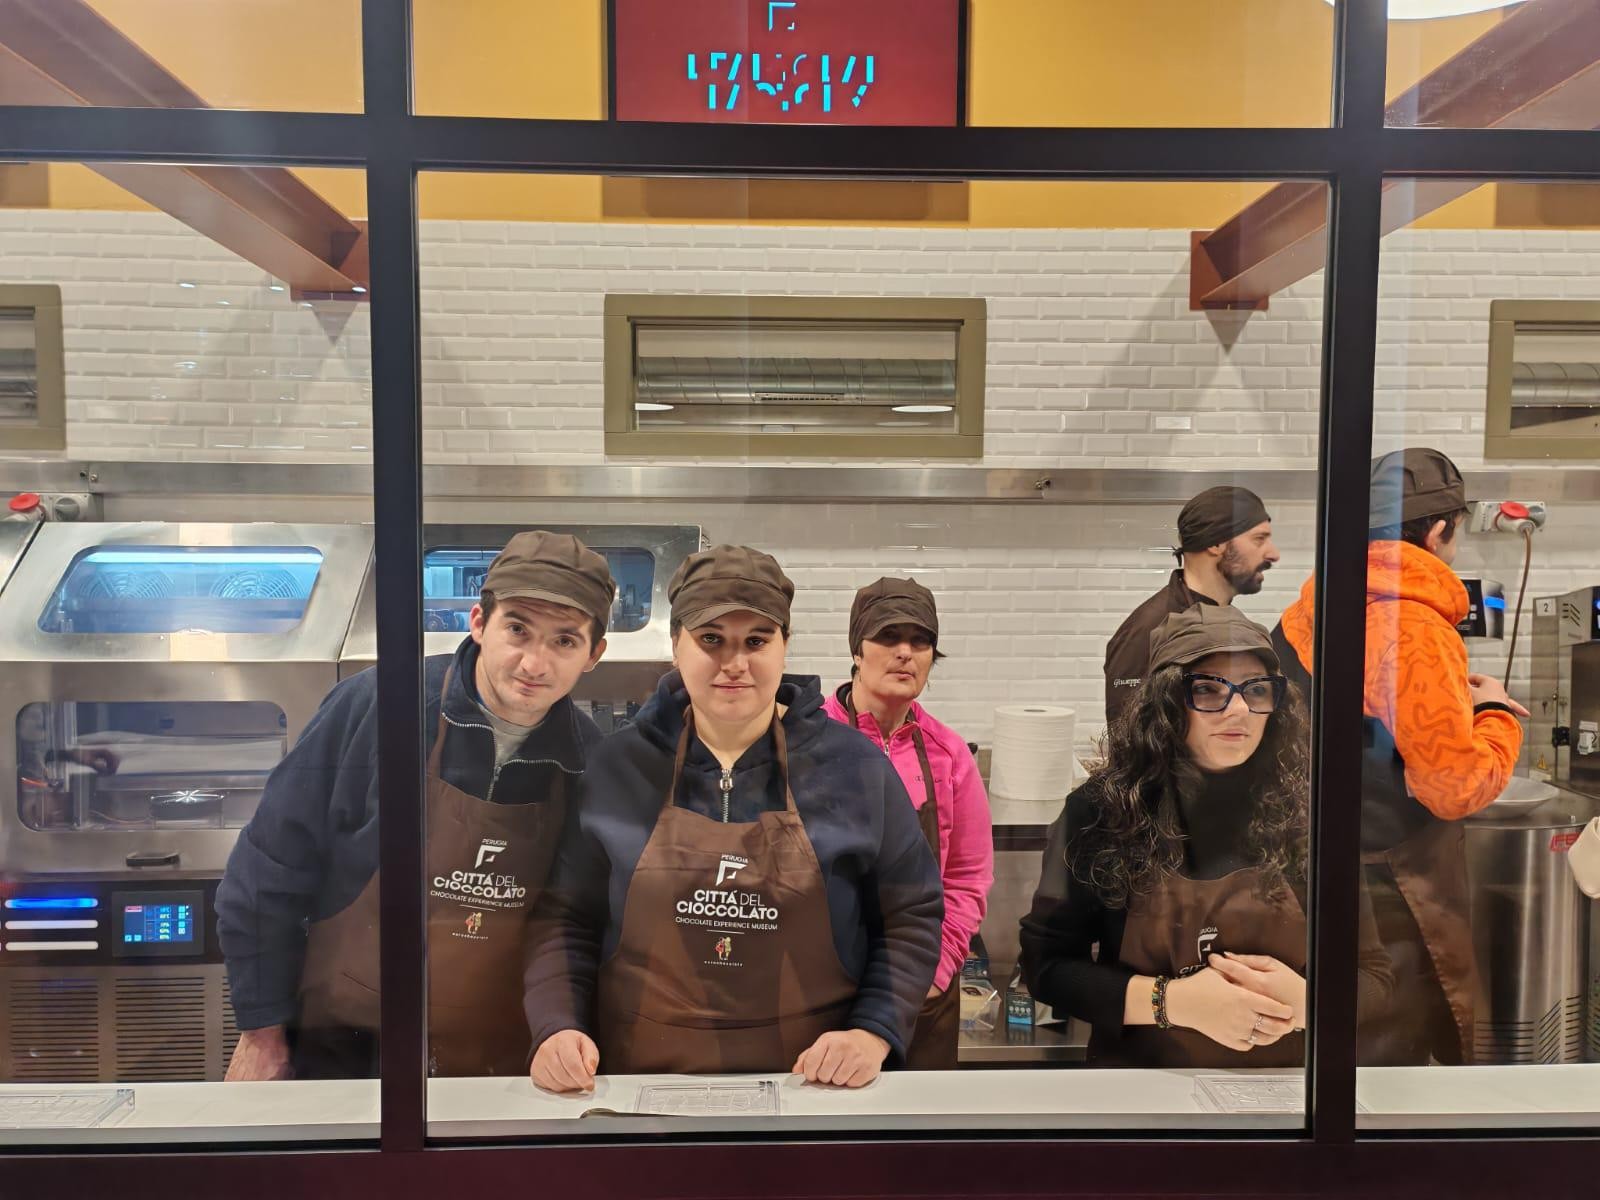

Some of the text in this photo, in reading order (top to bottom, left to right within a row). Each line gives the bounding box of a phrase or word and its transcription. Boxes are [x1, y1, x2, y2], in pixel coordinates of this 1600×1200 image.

[1543, 602, 1549, 612] 2
[433, 876, 526, 899] CIOCCOLATO
[495, 875, 518, 887] DEL
[430, 889, 467, 902] CHOCOLATE
[740, 892, 765, 906] DEL
[676, 900, 779, 920] CIOCCOLATO
[675, 916, 713, 926] CHOCOLATE
[713, 920, 750, 929] EXPERIENCE
